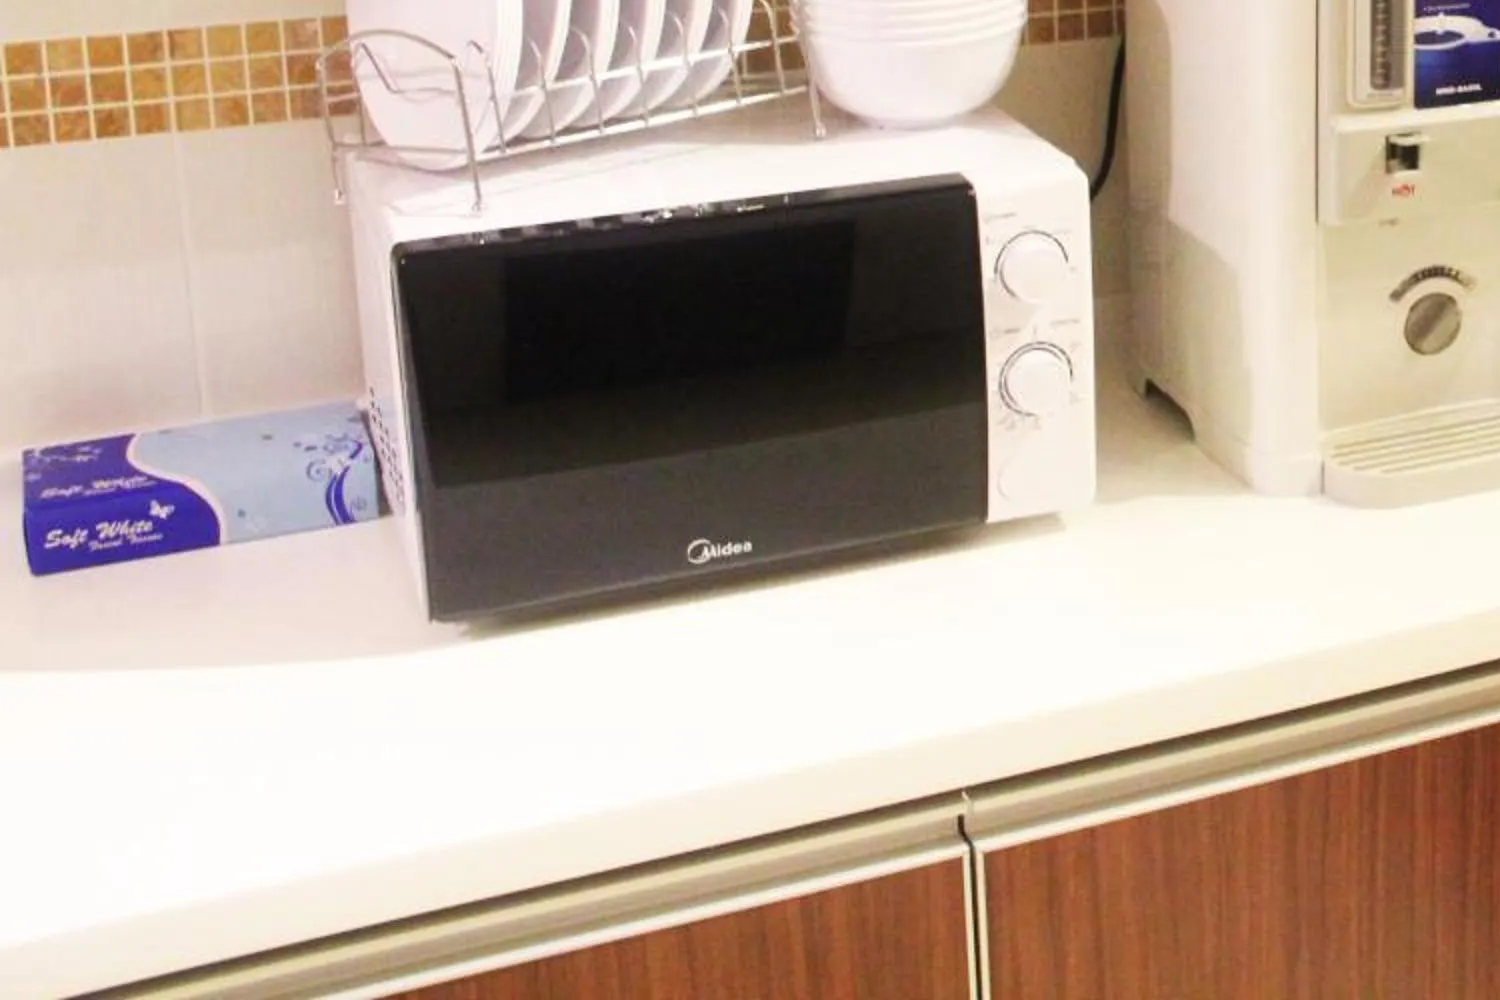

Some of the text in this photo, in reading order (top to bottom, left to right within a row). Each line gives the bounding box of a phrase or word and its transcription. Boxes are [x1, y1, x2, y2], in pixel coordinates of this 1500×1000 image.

[44, 527, 89, 549] Soft
[96, 519, 154, 539] White
[689, 539, 753, 563] Midea
